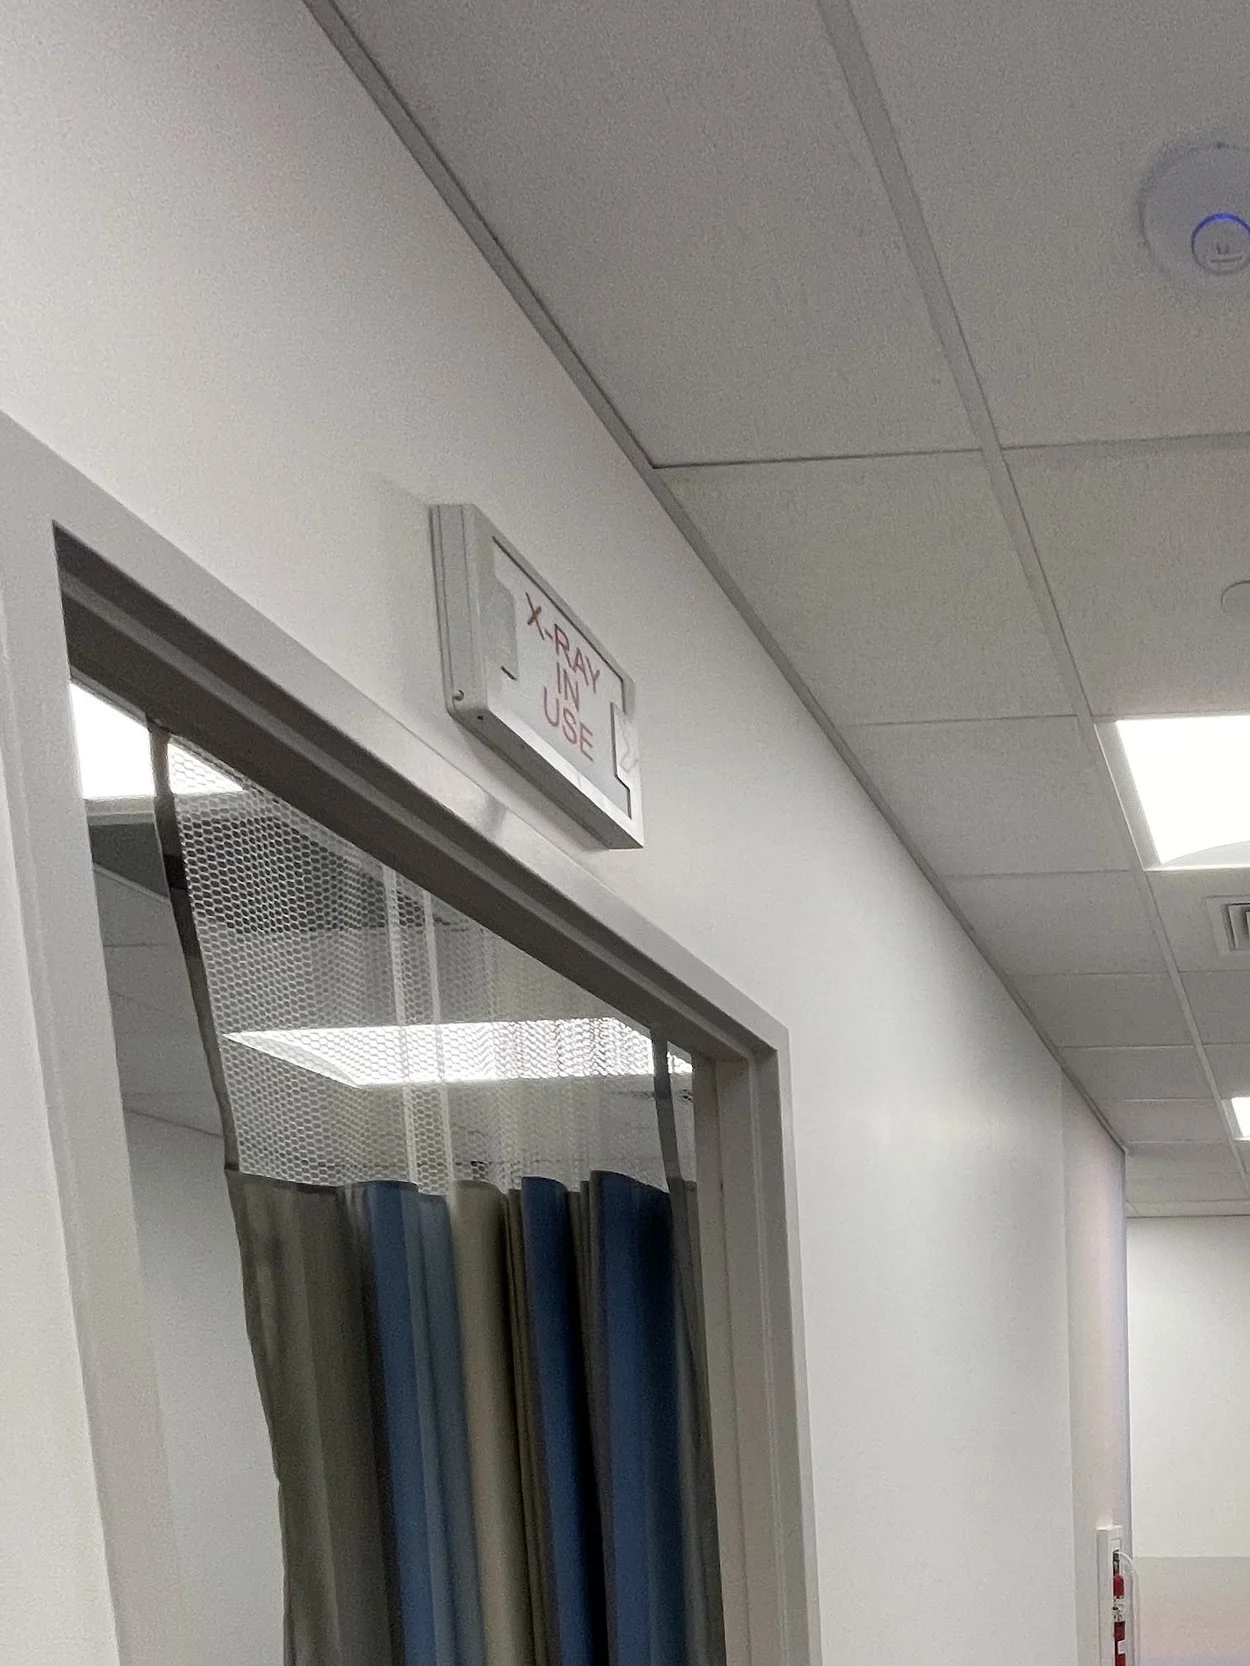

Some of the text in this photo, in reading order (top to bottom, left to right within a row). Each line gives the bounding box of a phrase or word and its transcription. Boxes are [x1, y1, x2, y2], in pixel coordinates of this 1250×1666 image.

[526, 592, 600, 694] X-RAY
[543, 686, 594, 762] USE
[556, 661, 580, 712] IN
